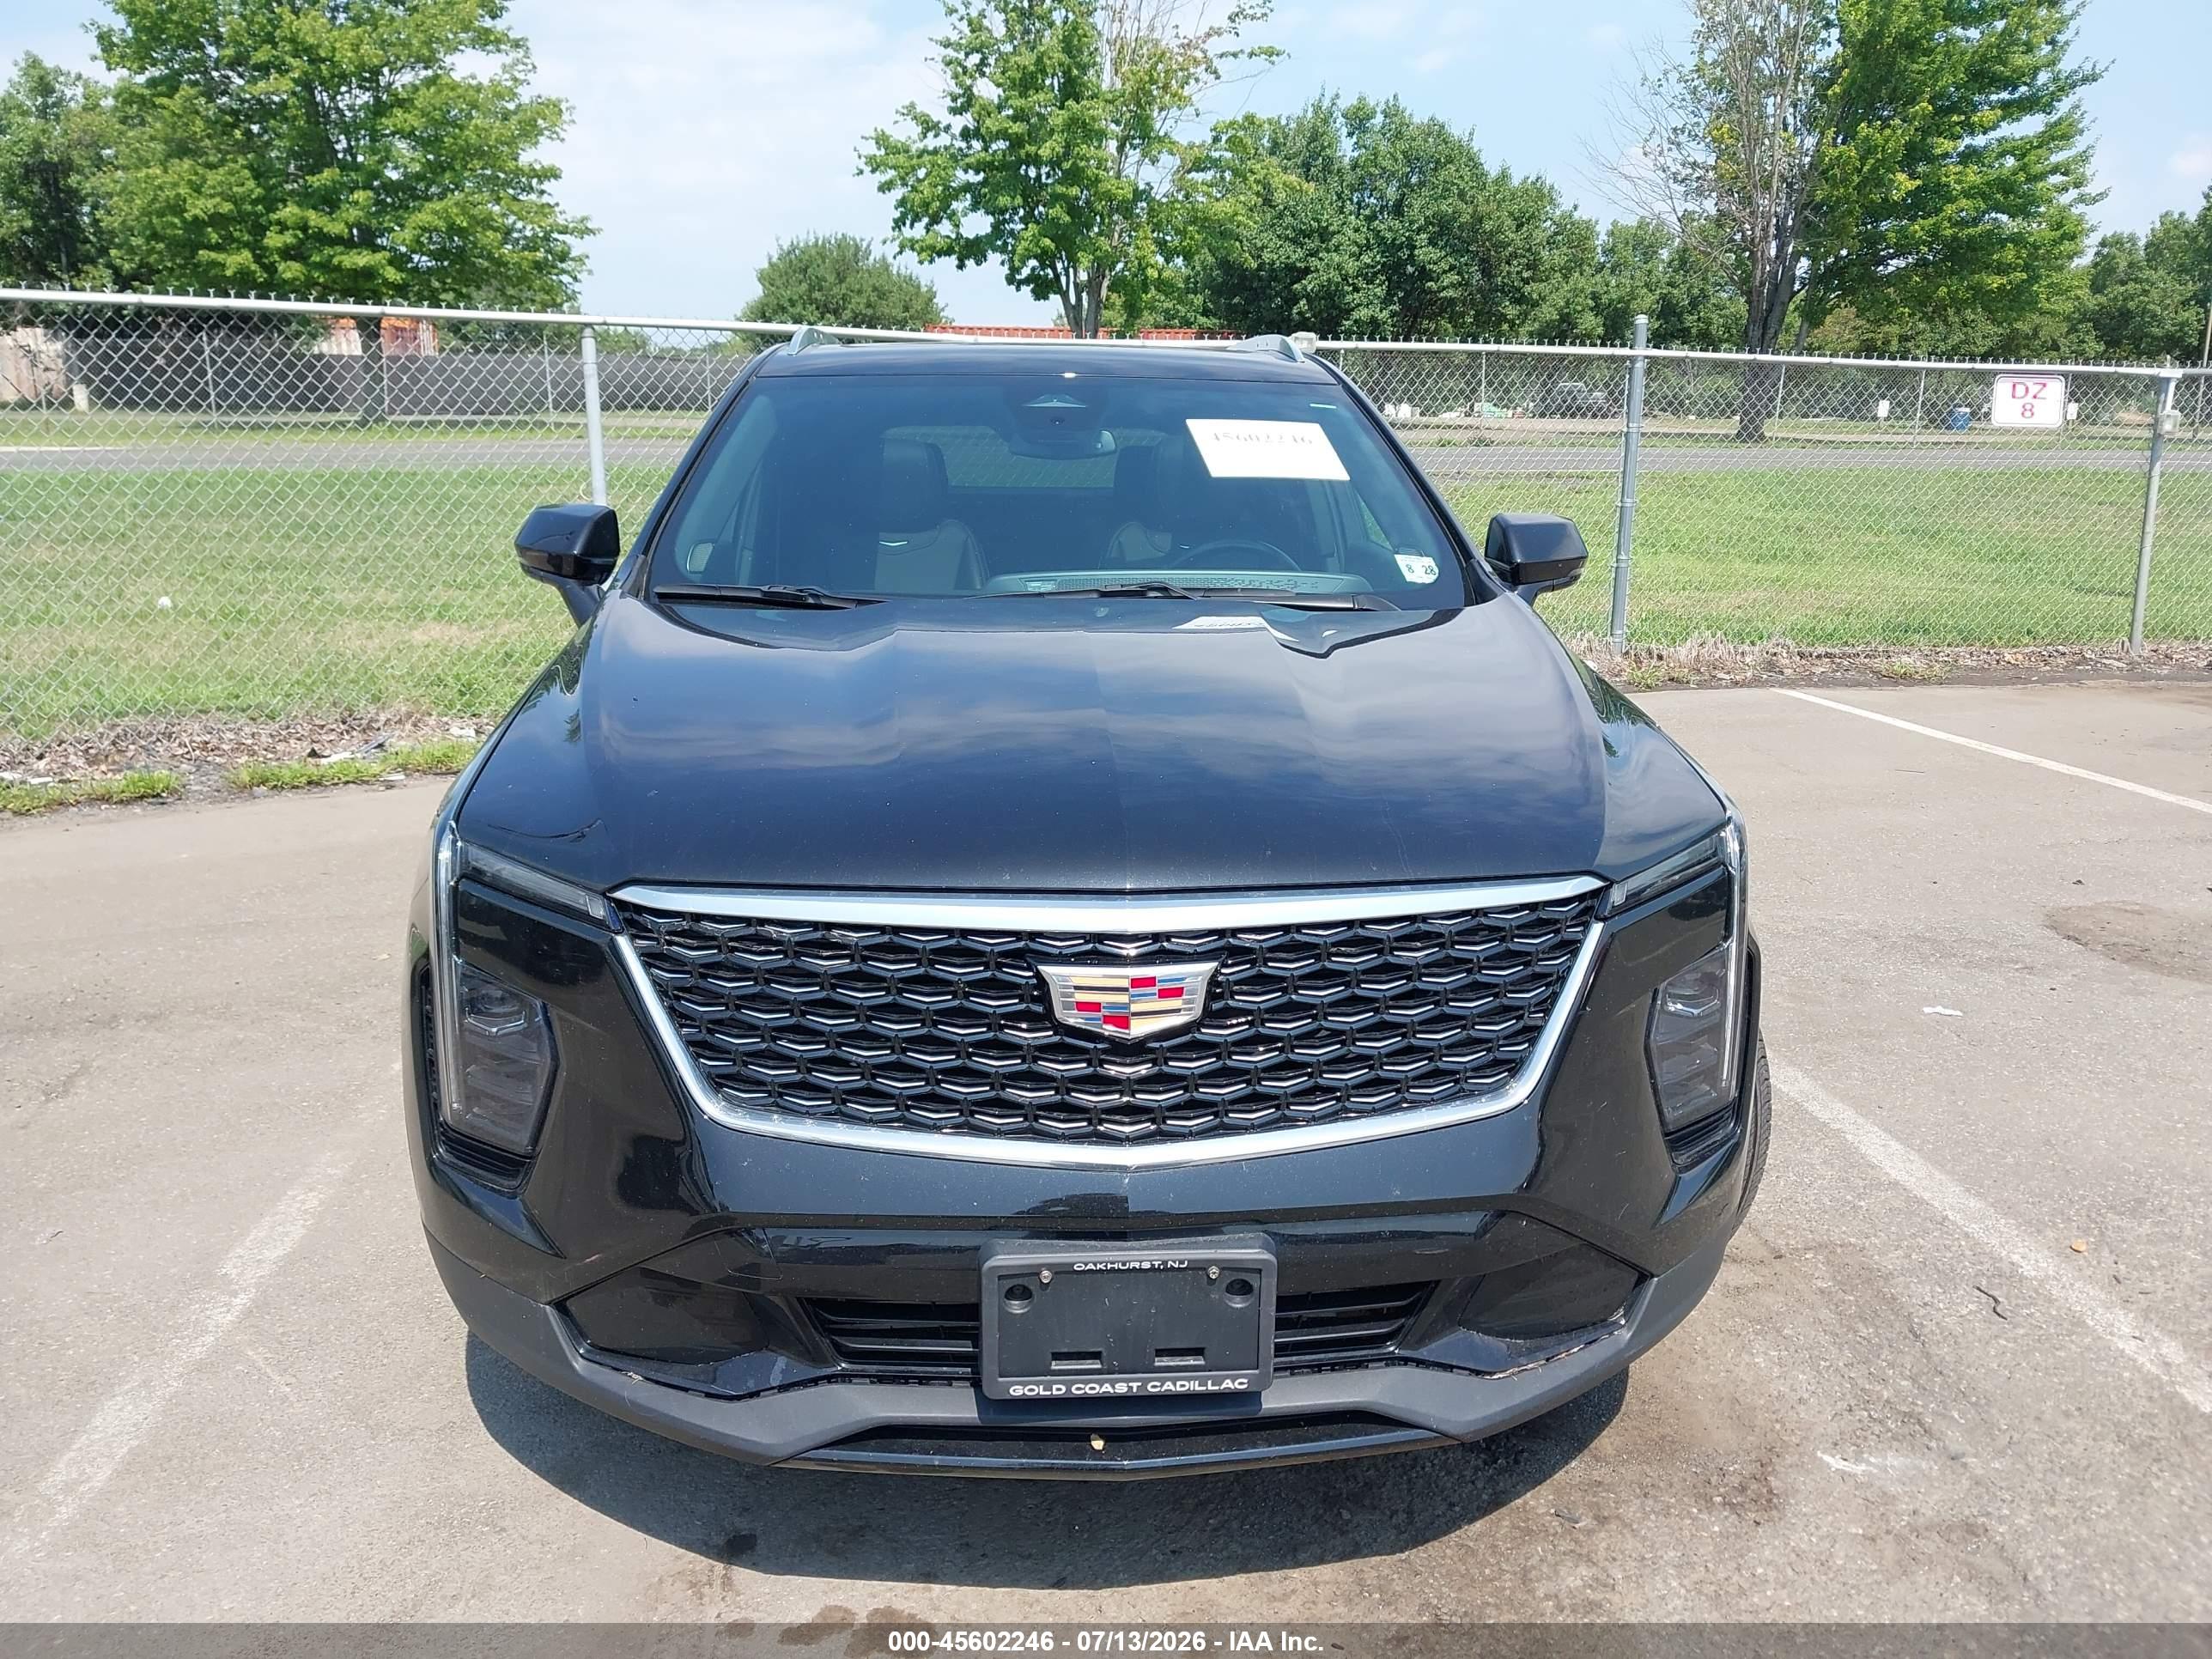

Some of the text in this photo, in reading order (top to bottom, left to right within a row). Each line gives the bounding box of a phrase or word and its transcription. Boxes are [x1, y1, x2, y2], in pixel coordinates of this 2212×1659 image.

[2011, 381, 2048, 400] DZ
[2021, 402, 2035, 419] 8
[1405, 563, 1437, 575] 8 28
[1073, 1260, 1188, 1272] OAKHURST, NJ
[1009, 1378, 1249, 1396] GOLD COAST CADILLAC
